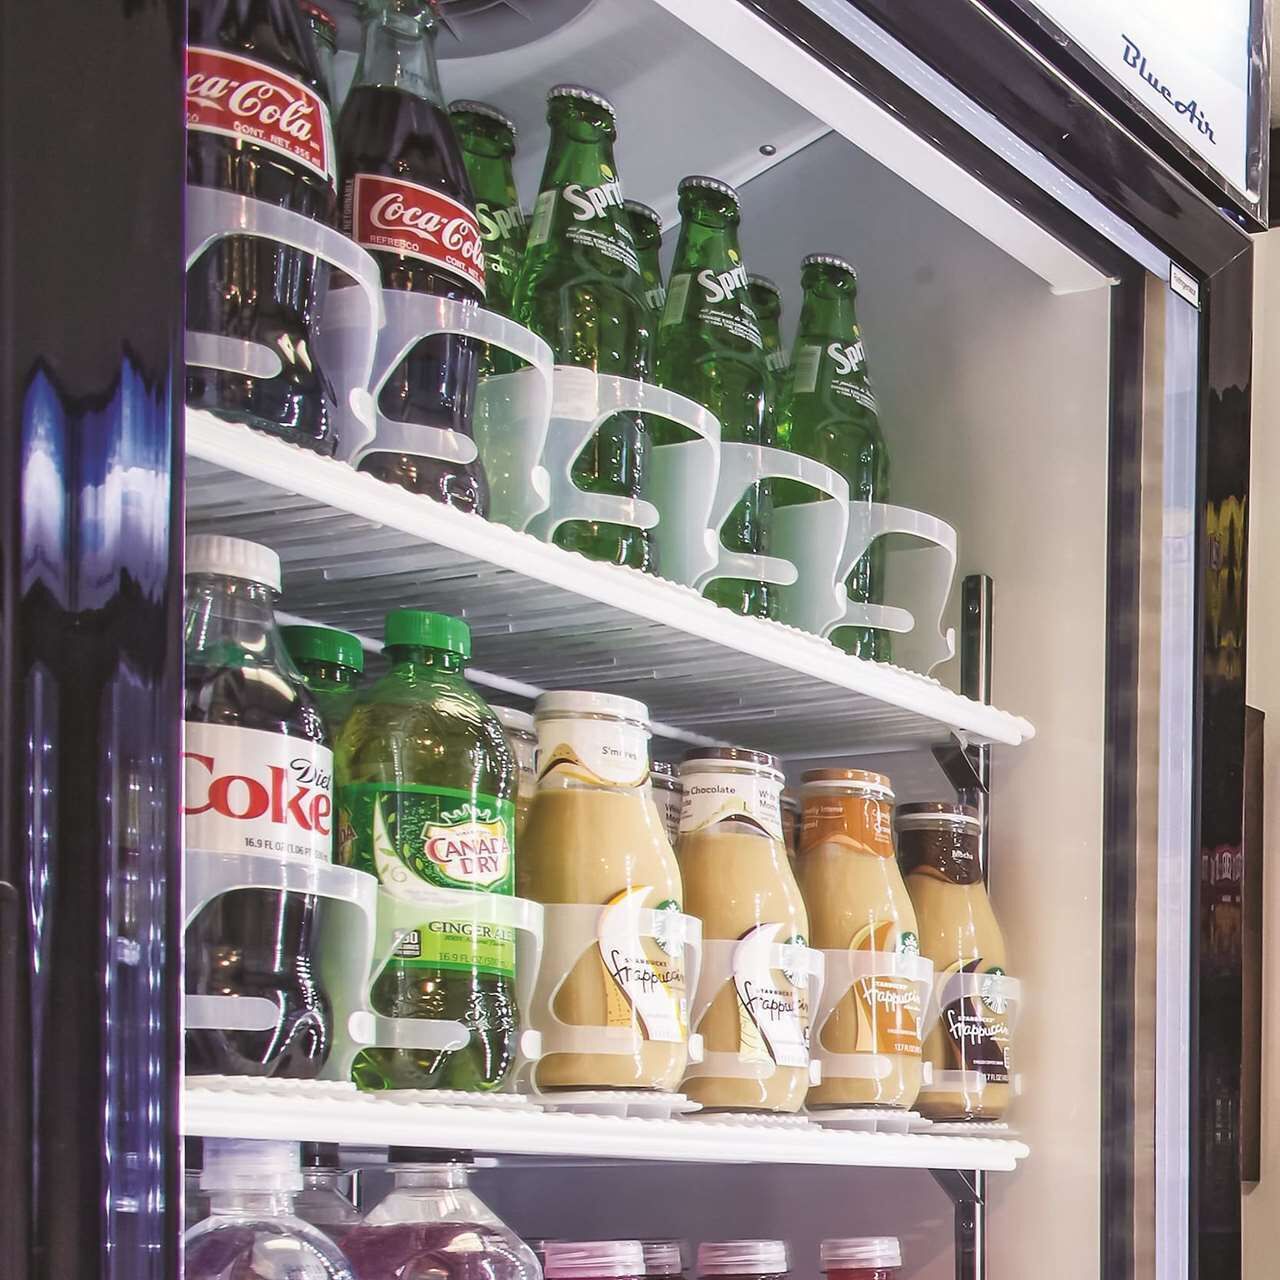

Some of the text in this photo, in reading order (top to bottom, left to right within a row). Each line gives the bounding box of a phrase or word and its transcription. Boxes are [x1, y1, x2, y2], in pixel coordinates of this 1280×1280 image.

[187, 73, 314, 142] ca-Cola
[369, 192, 485, 270] Coca-Cola
[369, 234, 420, 252] REFRESCO
[290, 758, 331, 791] Diet
[690, 784, 736, 797] Chocolate
[427, 836, 510, 865] CANADA
[461, 855, 500, 875] DRY
[428, 920, 492, 937] GINGER
